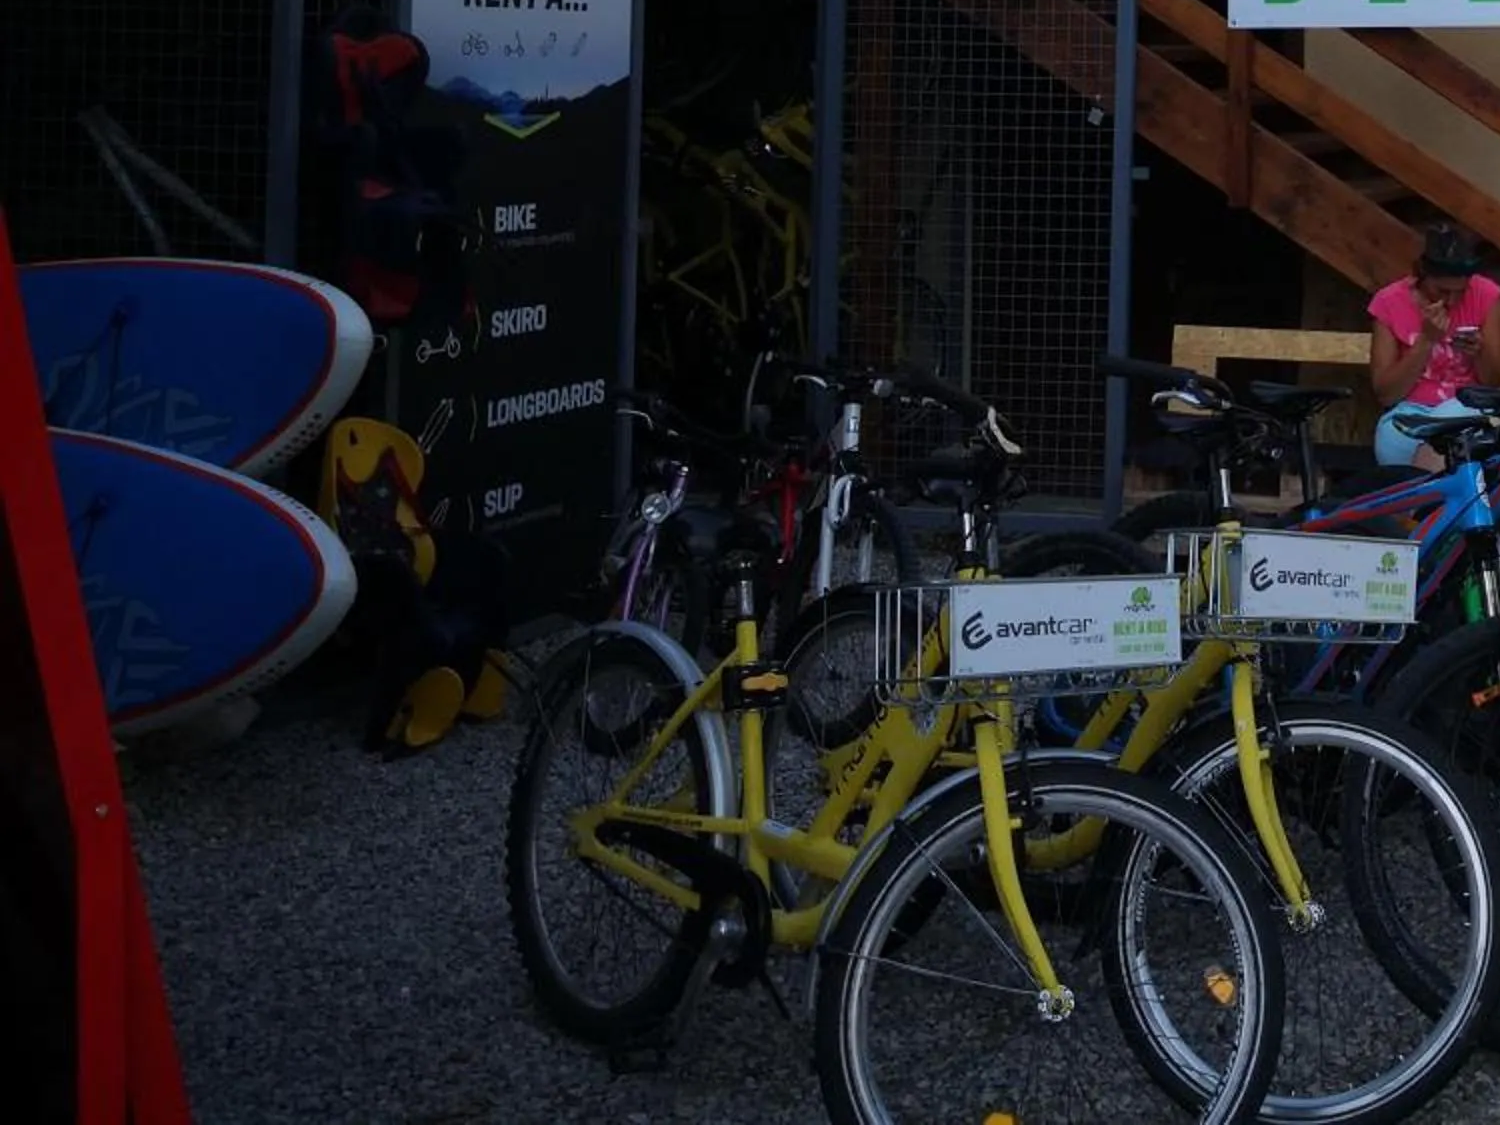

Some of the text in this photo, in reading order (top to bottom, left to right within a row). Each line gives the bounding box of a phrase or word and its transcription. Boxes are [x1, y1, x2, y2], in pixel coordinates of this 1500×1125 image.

[494, 203, 537, 234] BIKE
[490, 303, 547, 338] SKIRO
[487, 378, 606, 429] LONGBOARDS
[484, 483, 524, 518] SUP
[1277, 568, 1352, 588] avantcar
[996, 615, 1093, 639] avantcar
